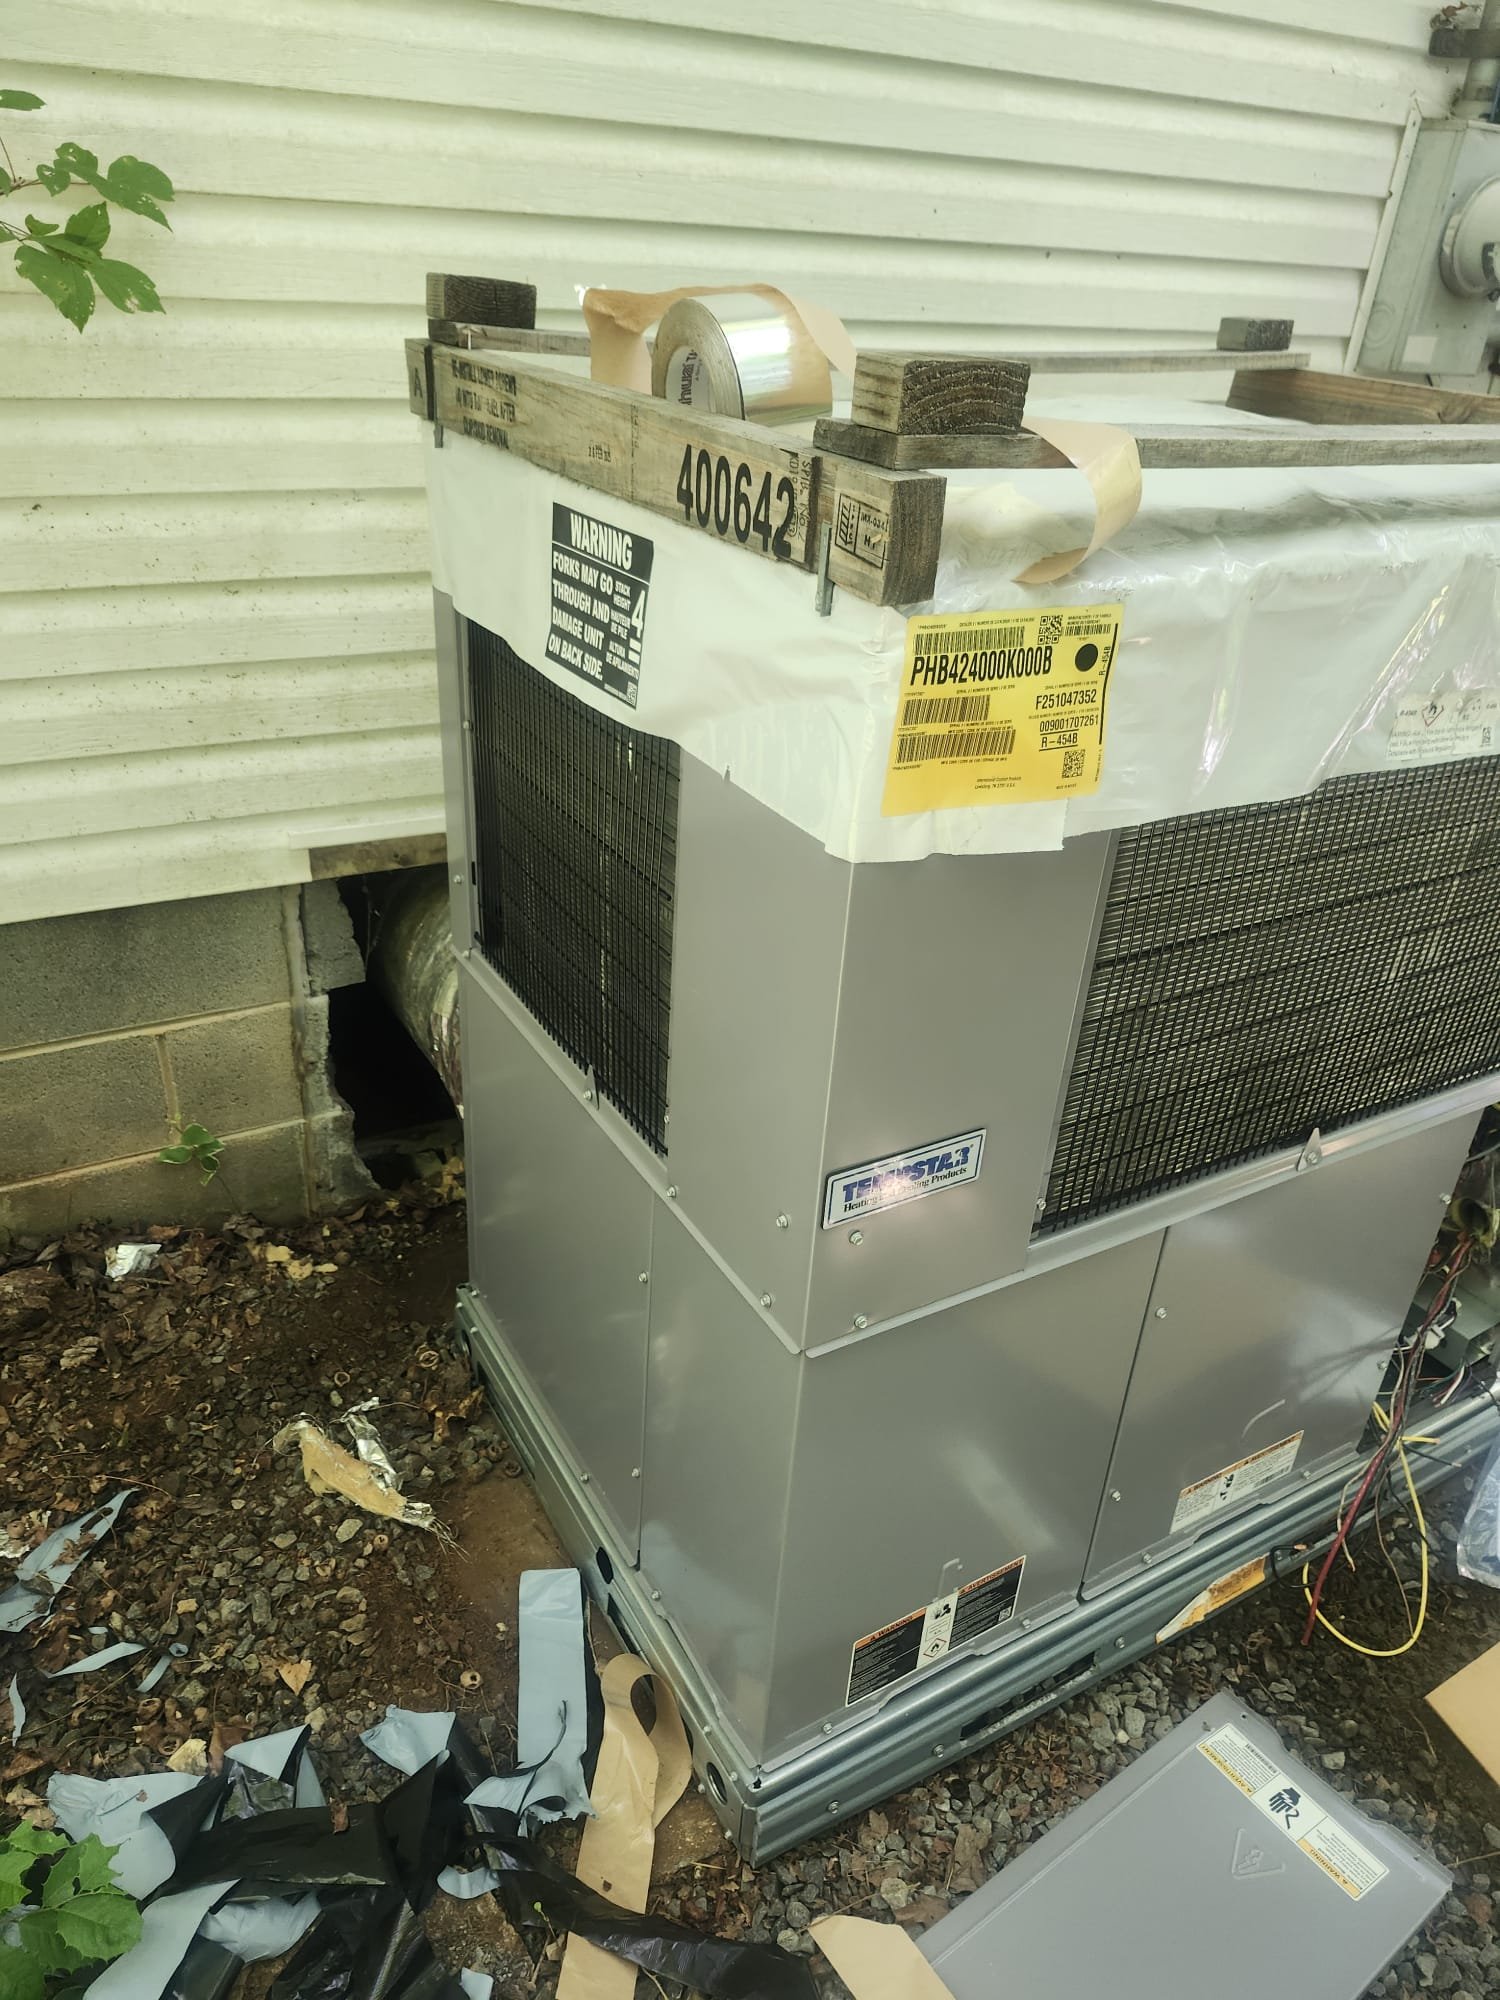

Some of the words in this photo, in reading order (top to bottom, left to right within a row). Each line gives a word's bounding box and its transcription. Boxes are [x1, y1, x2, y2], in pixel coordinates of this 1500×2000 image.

[676, 443, 795, 559] 400642
[570, 512, 633, 571] WARNING
[553, 551, 580, 580] FORKS
[581, 563, 599, 589] MAY
[600, 572, 614, 596] GO
[614, 580, 631, 598] STACK
[553, 578, 592, 615] THROUGH
[592, 598, 610, 624] AND
[631, 589, 646, 639] 4
[552, 605, 584, 640] DAMAGE
[584, 623, 605, 651] UNIT
[548, 633, 562, 656] ON
[561, 639, 584, 669] BACK
[910, 645, 1053, 686] PHB424000K000B
[1035, 688, 1097, 711] F251047352
[1039, 714, 1099, 733] 009001707261
[931, 1167, 968, 1184] Products
